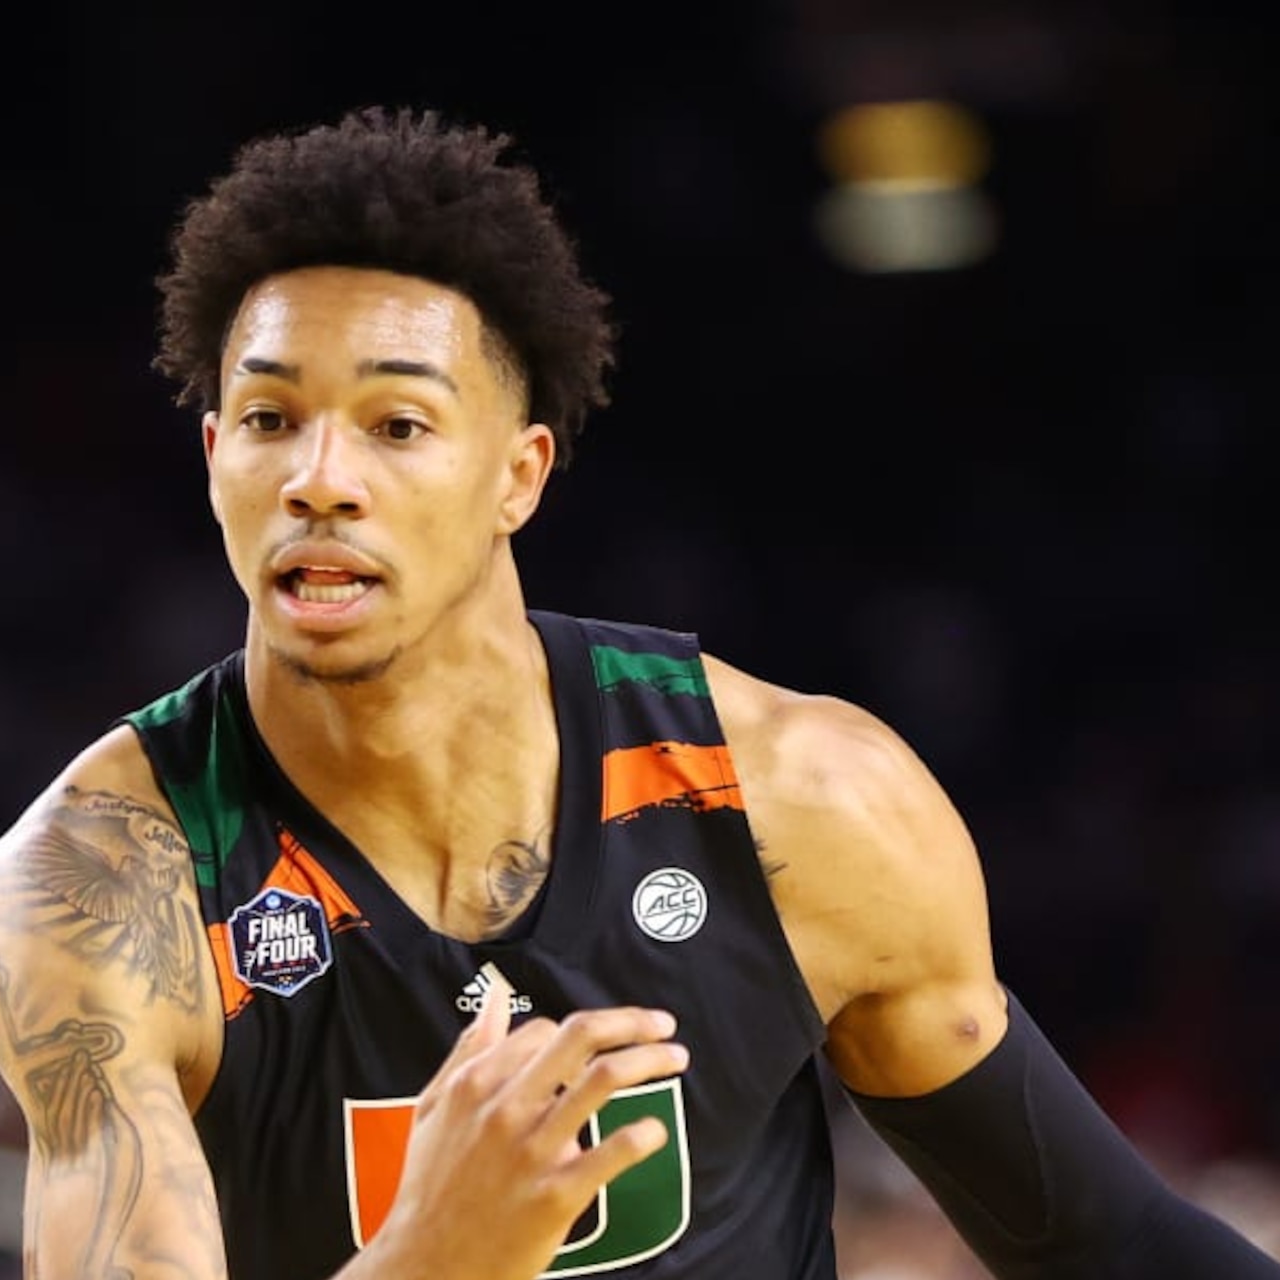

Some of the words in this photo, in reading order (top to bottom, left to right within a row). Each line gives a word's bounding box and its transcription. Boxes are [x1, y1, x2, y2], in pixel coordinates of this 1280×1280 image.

[646, 886, 696, 914] ACC
[248, 911, 310, 944] FINAL
[256, 935, 319, 967] FOUR
[455, 993, 533, 1015] adas
